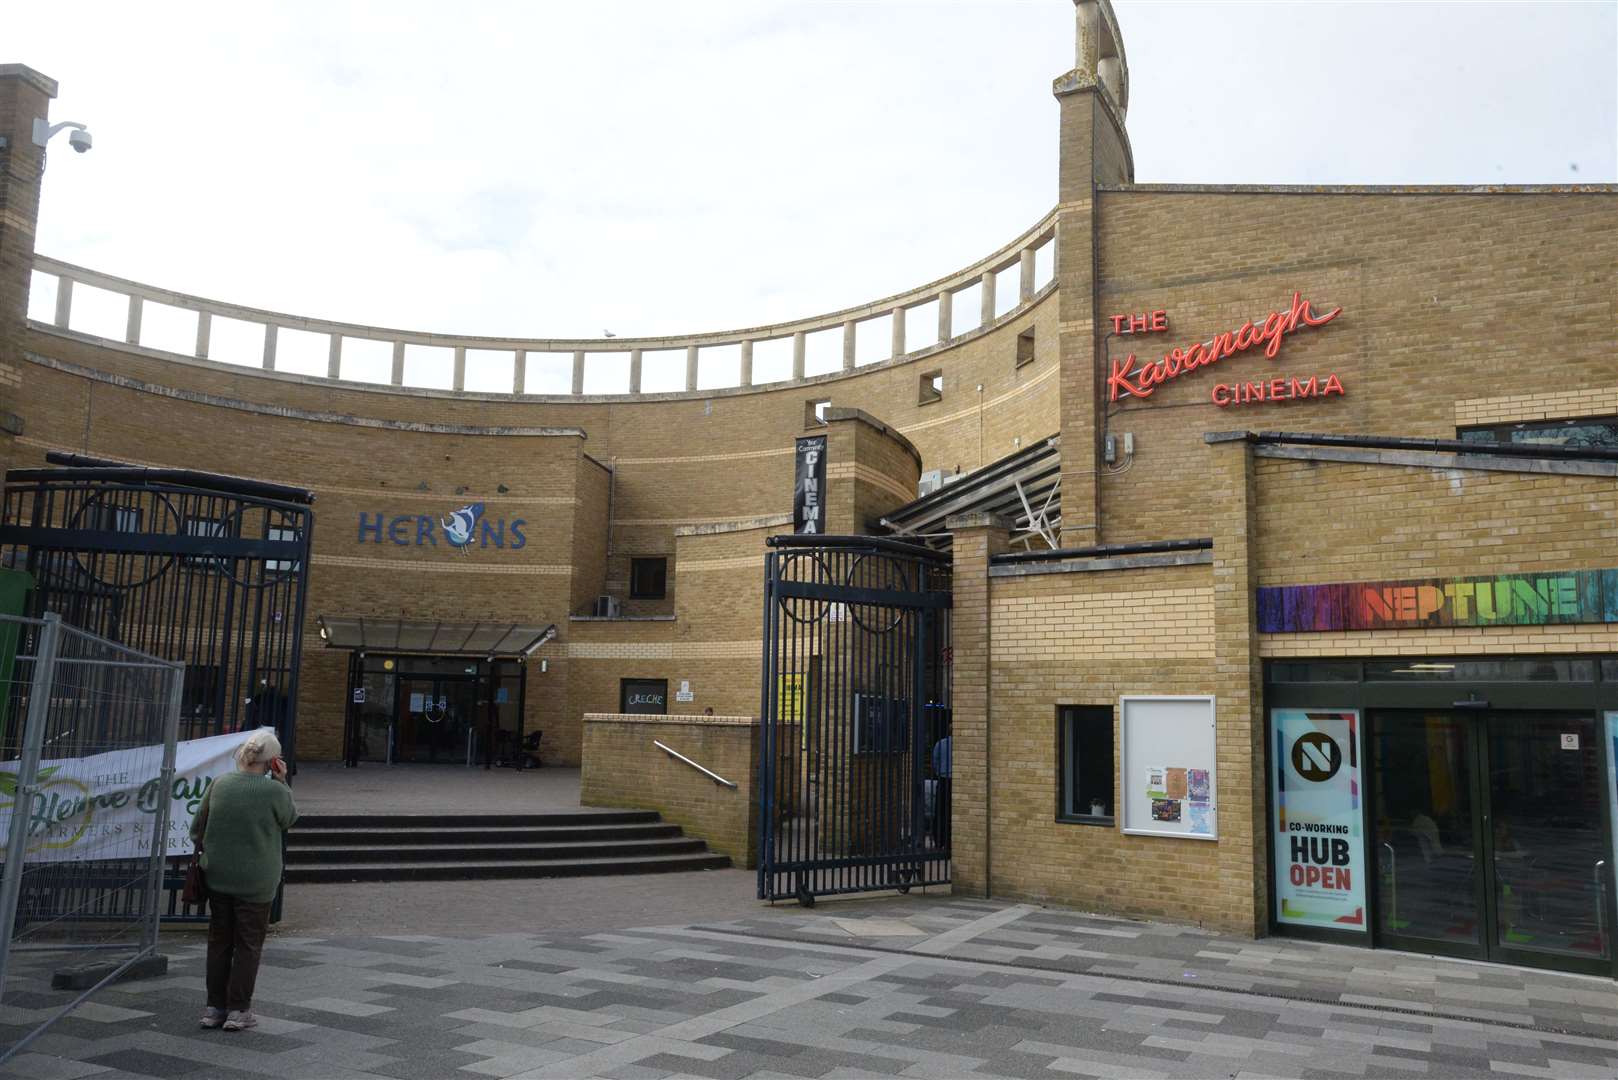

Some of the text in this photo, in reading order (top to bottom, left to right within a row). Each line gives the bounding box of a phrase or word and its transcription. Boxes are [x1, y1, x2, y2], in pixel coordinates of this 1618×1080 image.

[1109, 310, 1168, 335] THE
[1107, 291, 1342, 401] Kavanagh
[1212, 373, 1345, 408] CINEMA
[802, 451, 819, 533] CINEMA
[358, 502, 527, 551] HERONS
[1364, 577, 1578, 620] NEPTUNE
[1302, 741, 1331, 772] N
[96, 771, 129, 785] THE
[30, 790, 130, 832] Herne
[1289, 822, 1349, 835] CO-WORKING
[1291, 835, 1350, 866] HUB
[1290, 864, 1352, 891] OPEN
